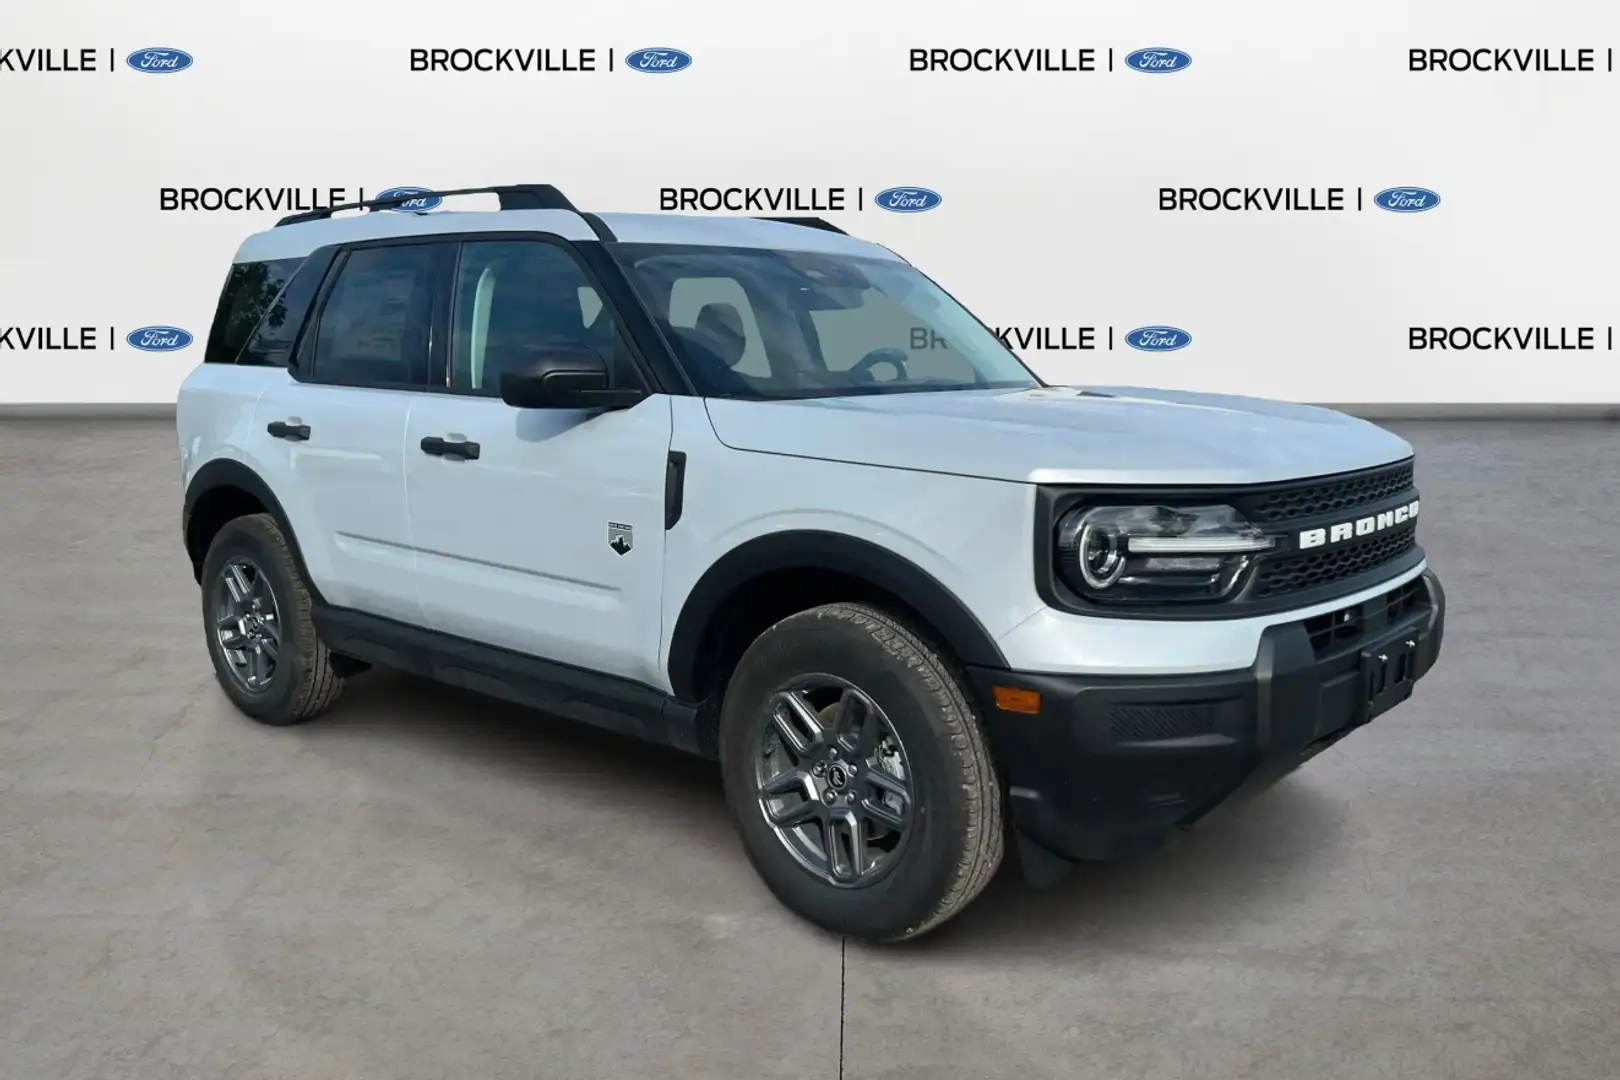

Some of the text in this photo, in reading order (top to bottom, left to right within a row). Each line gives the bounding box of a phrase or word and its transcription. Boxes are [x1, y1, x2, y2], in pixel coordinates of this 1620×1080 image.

[140, 51, 178, 68] Ford
[411, 49, 677, 71] BROCKVILLE Ford
[910, 49, 1176, 71] BROCKVILLE Ford
[1410, 49, 1594, 71] BROCKVILLE
[160, 188, 345, 210] BROCKVILLE
[660, 188, 927, 210] BROCKVILLE Ford
[1160, 188, 1426, 210] BROCKVILLE Ford
[140, 330, 178, 347] Ford
[910, 327, 1176, 350] BRKVILLE Ford
[1410, 327, 1594, 350] BROCKVILLE
[1299, 500, 1420, 549] BRONCO
